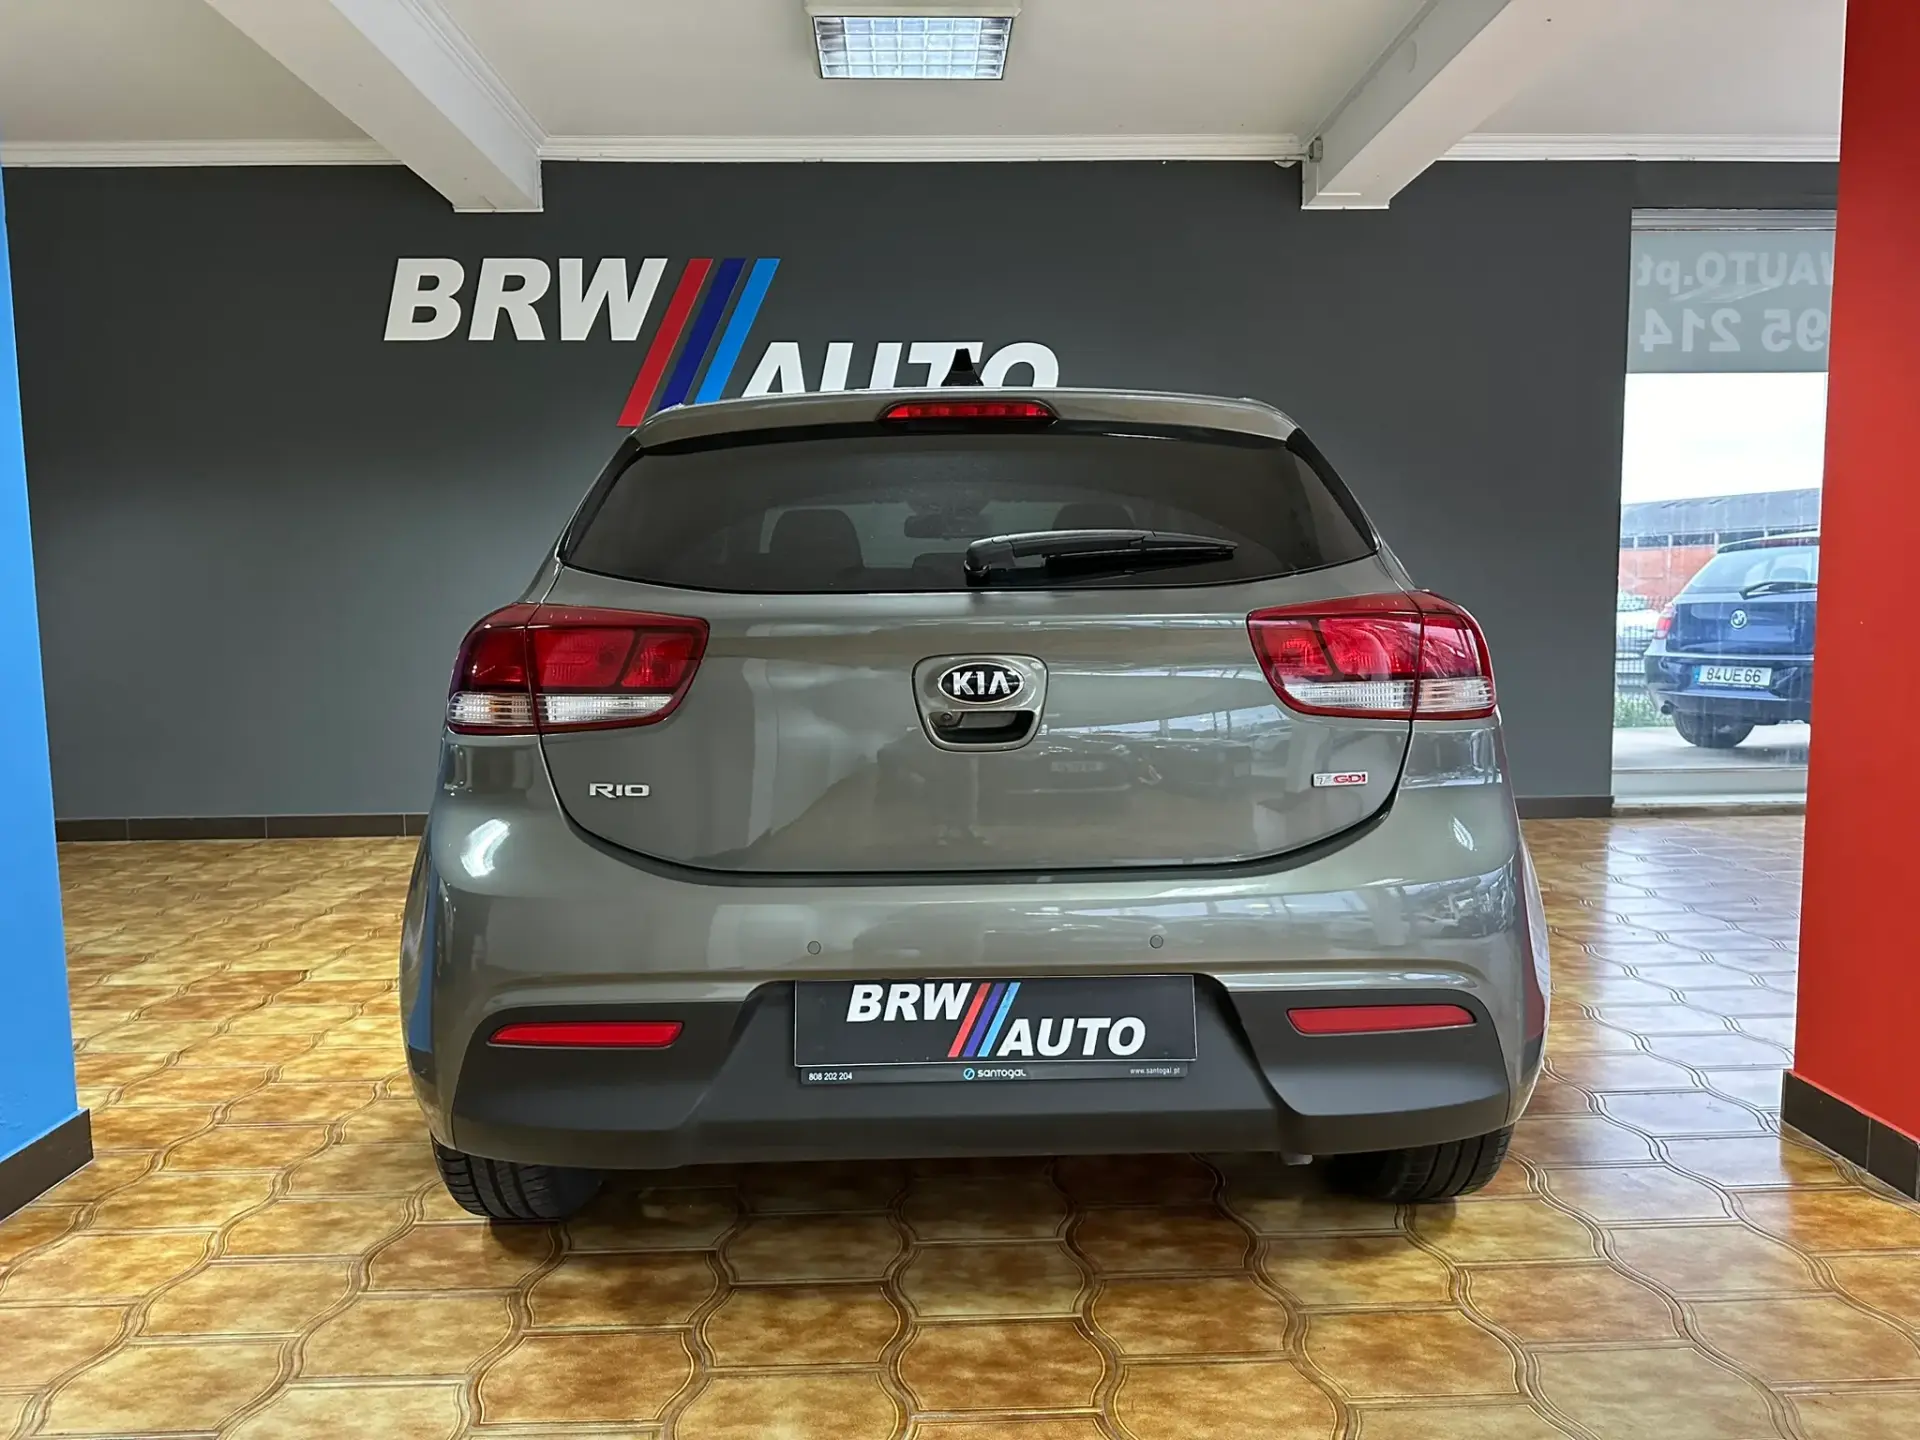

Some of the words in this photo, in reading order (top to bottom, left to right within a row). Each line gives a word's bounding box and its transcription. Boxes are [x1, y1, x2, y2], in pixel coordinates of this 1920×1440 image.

[383, 258, 668, 341] BRW
[952, 671, 1011, 695] KIA
[589, 783, 650, 799] RIO
[846, 982, 972, 1022] BRW
[996, 1016, 1146, 1057] AUTO
[808, 1072, 823, 1081] 808
[824, 1071, 838, 1081] 202
[839, 1071, 853, 1081] 204
